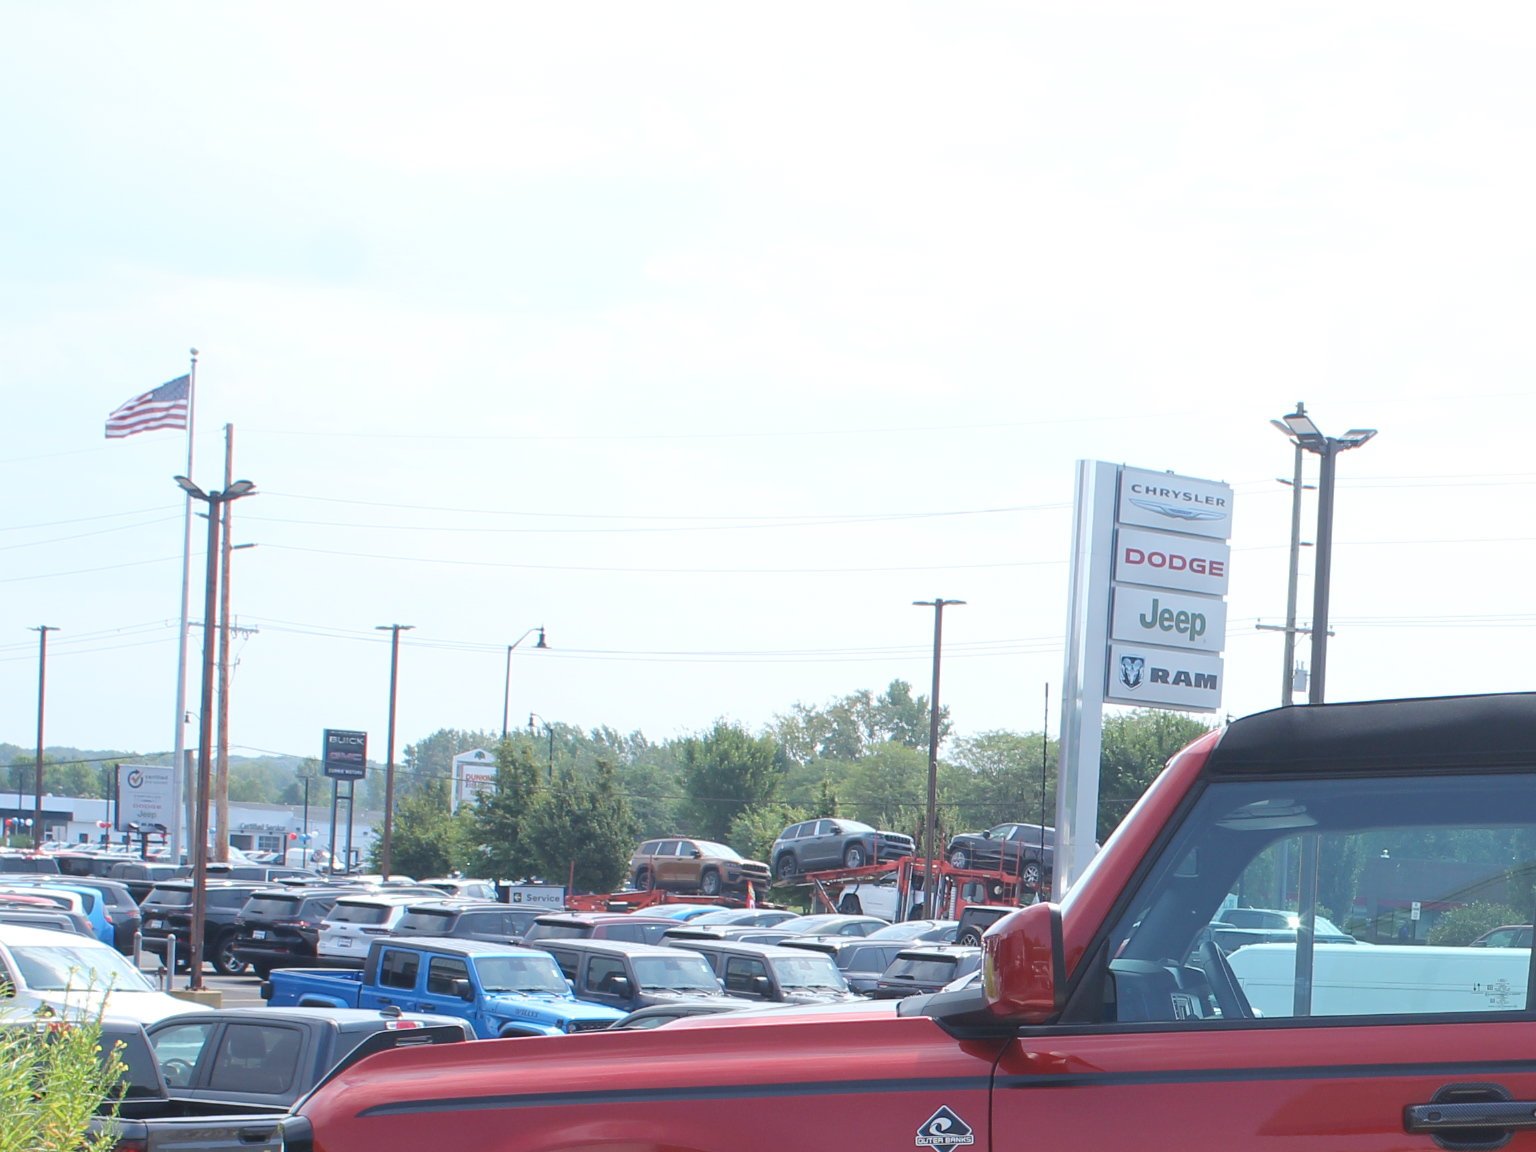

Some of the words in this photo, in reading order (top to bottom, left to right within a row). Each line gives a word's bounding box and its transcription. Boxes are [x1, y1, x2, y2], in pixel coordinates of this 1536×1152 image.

[1131, 483, 1226, 508] CHRYSLER
[1124, 547, 1225, 578] DODGE
[1139, 598, 1206, 642] Jeep
[1150, 667, 1218, 690] RAM
[328, 735, 365, 746] BUICK
[137, 810, 157, 819] Jeep
[526, 893, 560, 902] Service
